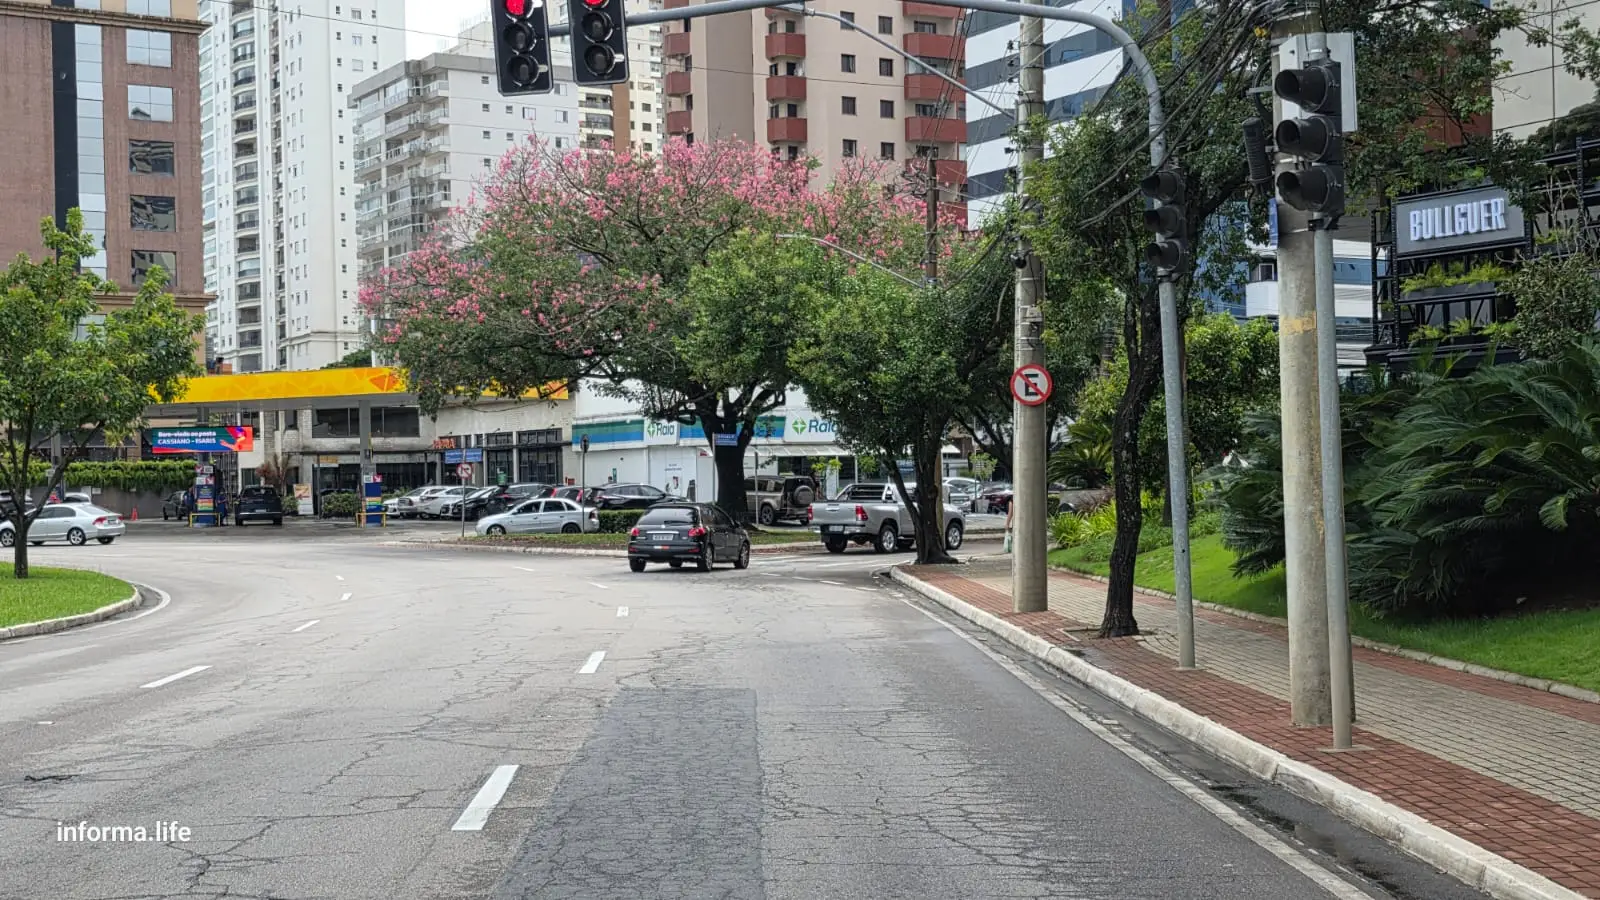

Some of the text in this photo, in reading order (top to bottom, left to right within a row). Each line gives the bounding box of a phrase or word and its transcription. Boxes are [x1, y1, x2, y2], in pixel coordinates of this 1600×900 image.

[1410, 198, 1506, 241] BULLGUER
[1024, 374, 1038, 396] E
[656, 422, 675, 436] Raia
